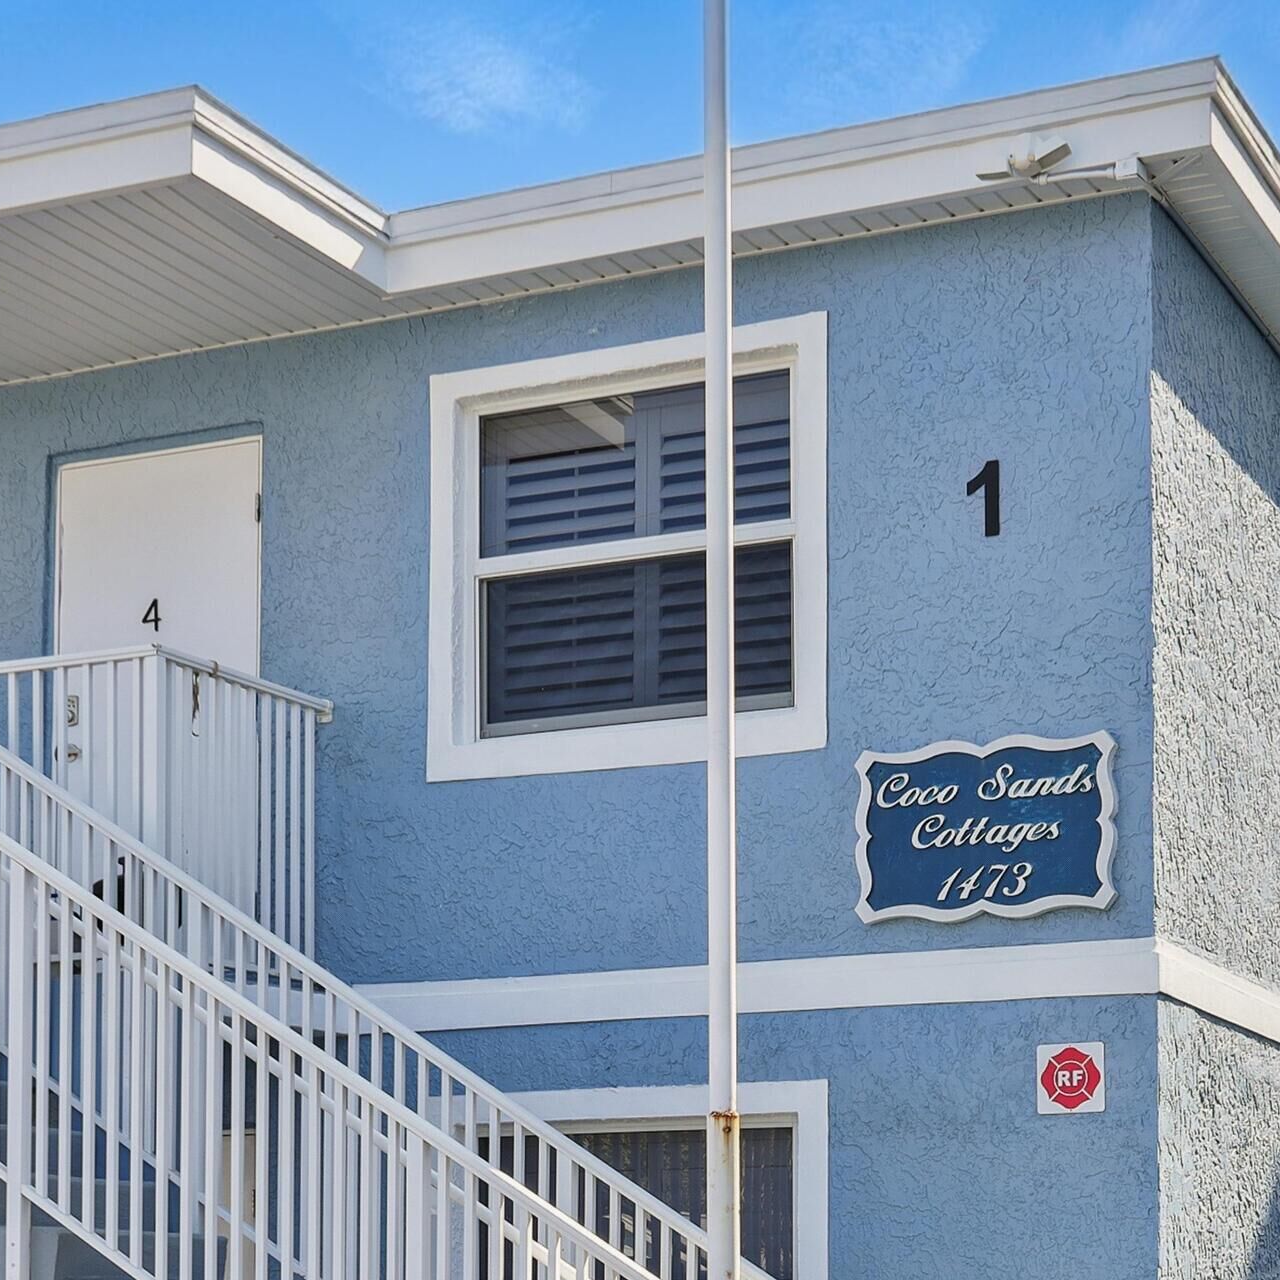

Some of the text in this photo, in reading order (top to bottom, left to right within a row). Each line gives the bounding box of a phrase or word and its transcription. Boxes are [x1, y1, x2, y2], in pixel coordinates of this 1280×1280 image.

[966, 459, 1000, 537] 1
[142, 598, 161, 632] 4
[876, 763, 1095, 809] Coco Sands
[911, 814, 1061, 853] Cottages
[936, 861, 1034, 901] 1473
[1057, 1070, 1084, 1087] RF
